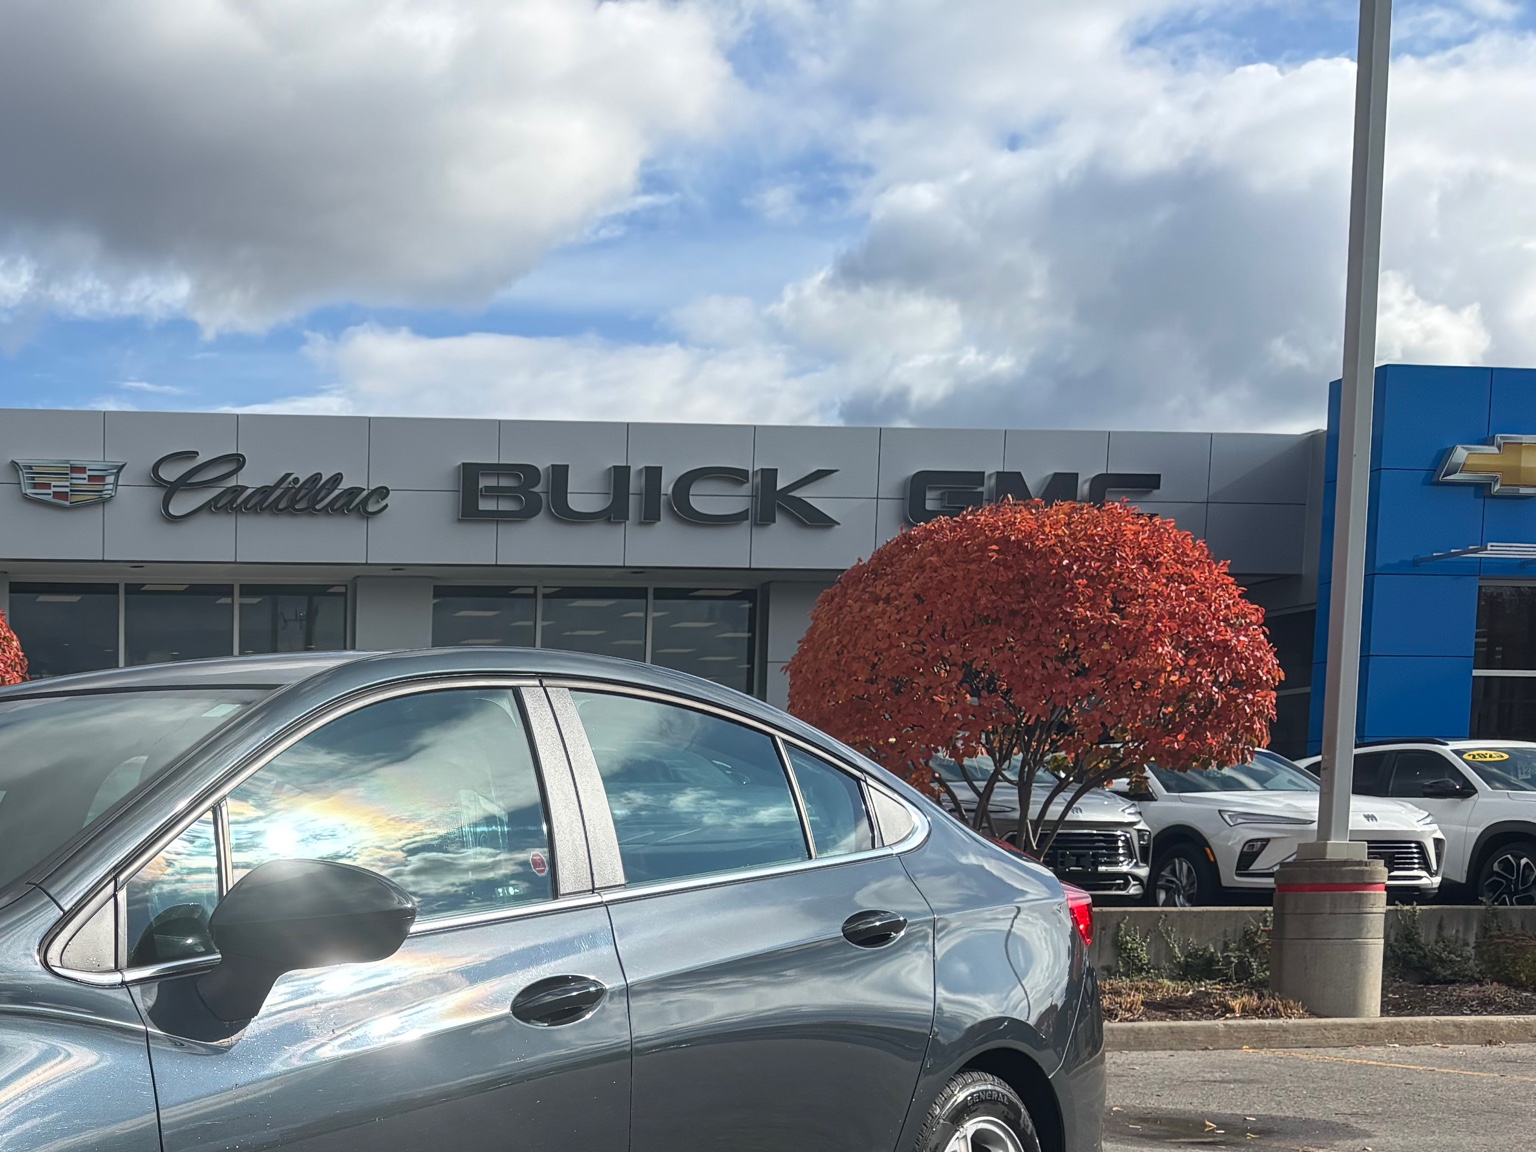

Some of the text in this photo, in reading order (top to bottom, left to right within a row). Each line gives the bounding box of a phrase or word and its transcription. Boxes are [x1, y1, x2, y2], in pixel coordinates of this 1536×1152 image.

[150, 450, 390, 521] Cadillac
[457, 461, 841, 526] BUICK
[966, 1090, 1009, 1107] GENERAL
